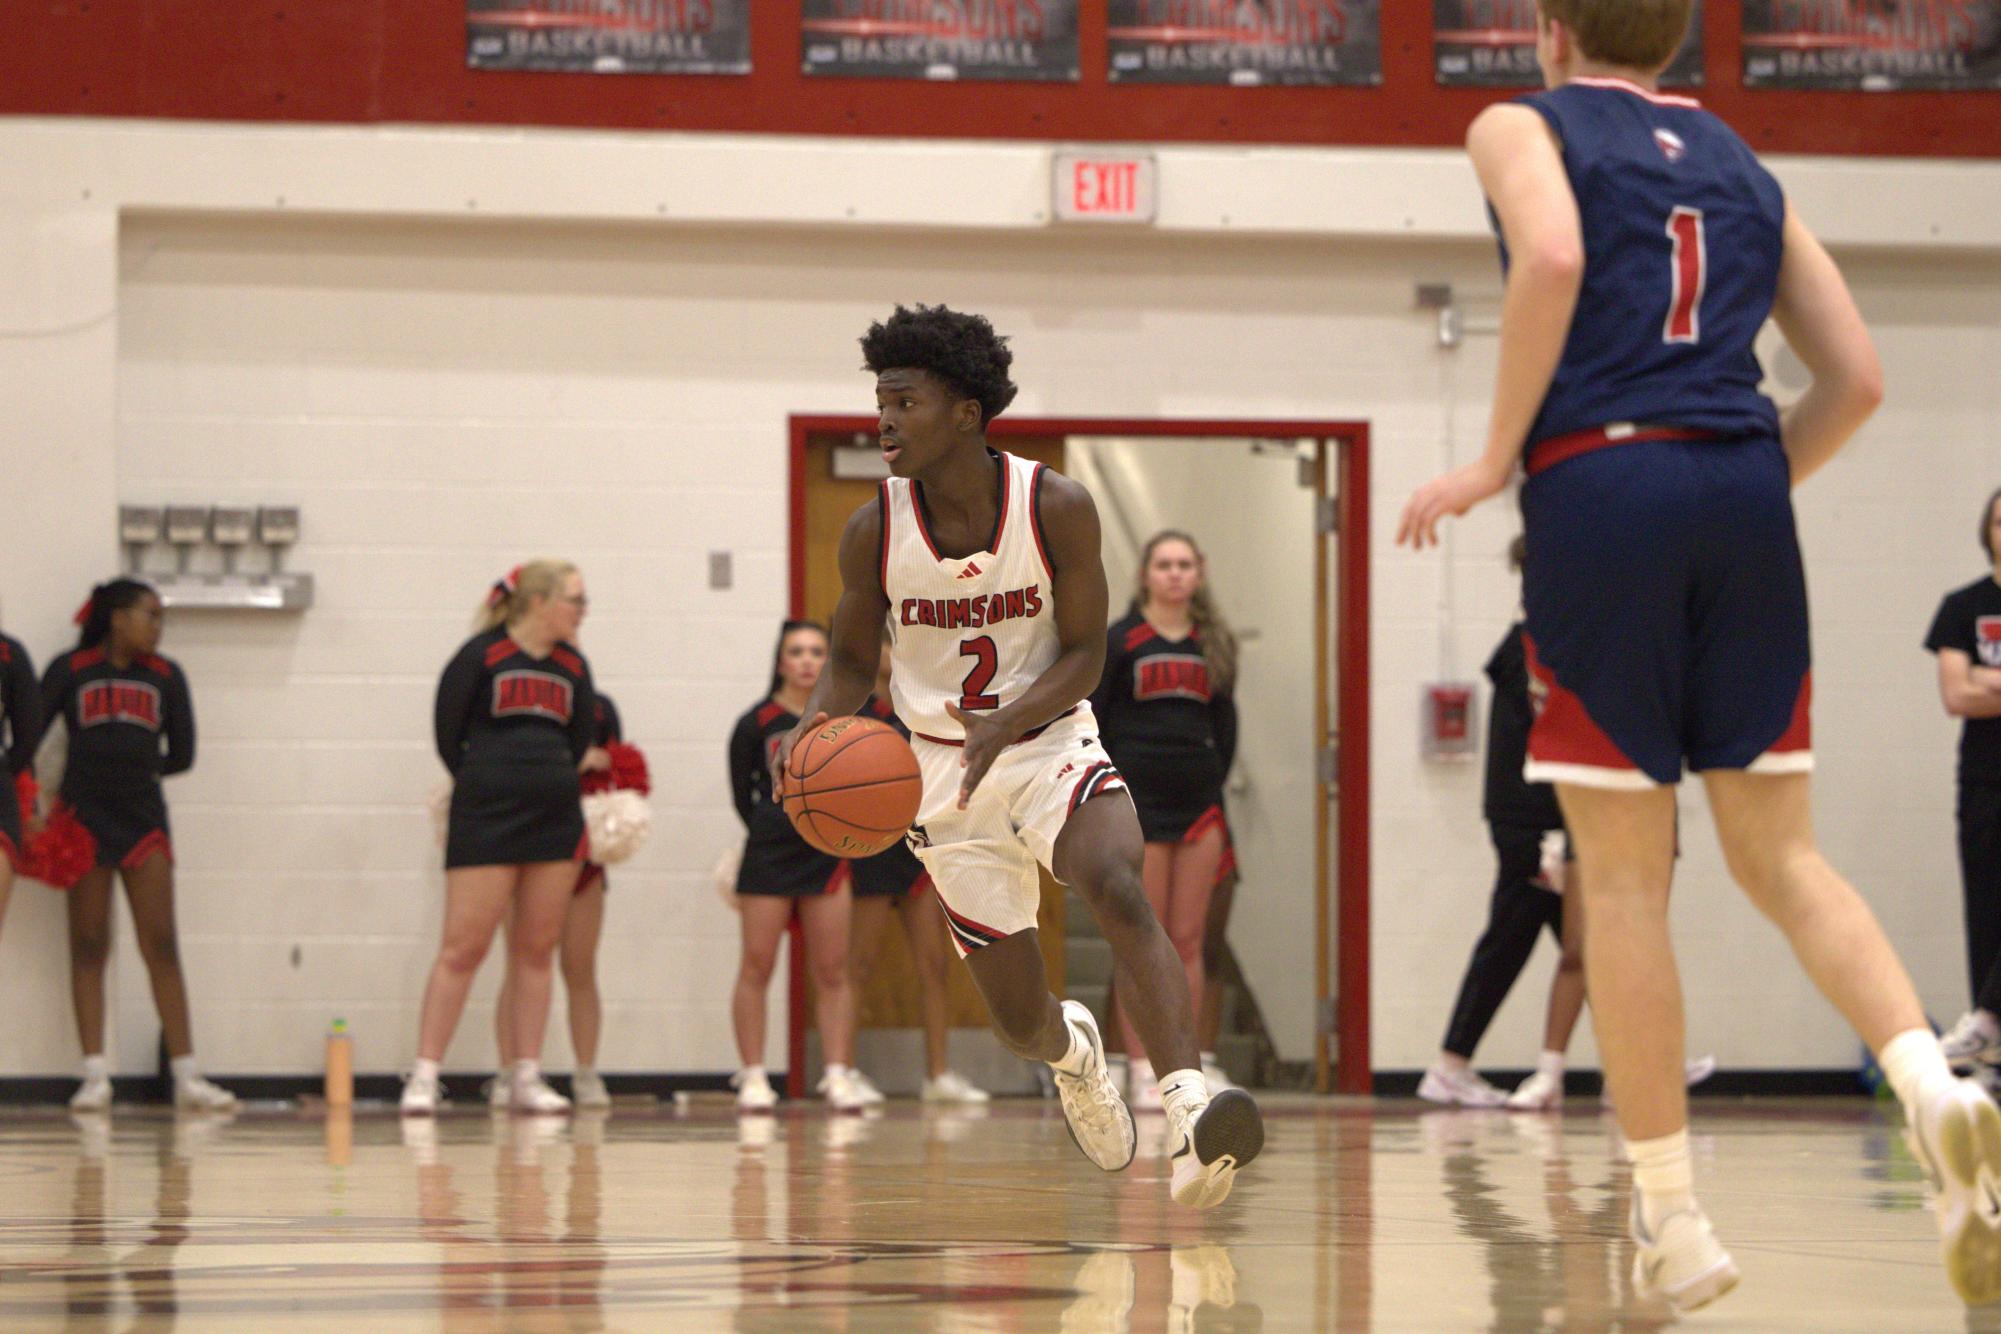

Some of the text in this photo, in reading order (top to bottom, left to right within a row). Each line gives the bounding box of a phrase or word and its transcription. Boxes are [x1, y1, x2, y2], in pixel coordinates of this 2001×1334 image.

[1074, 161, 1137, 212] EXIT
[1662, 205, 1707, 345] 1
[901, 584, 1043, 630] CRIMSONS
[959, 635, 999, 711] 2
